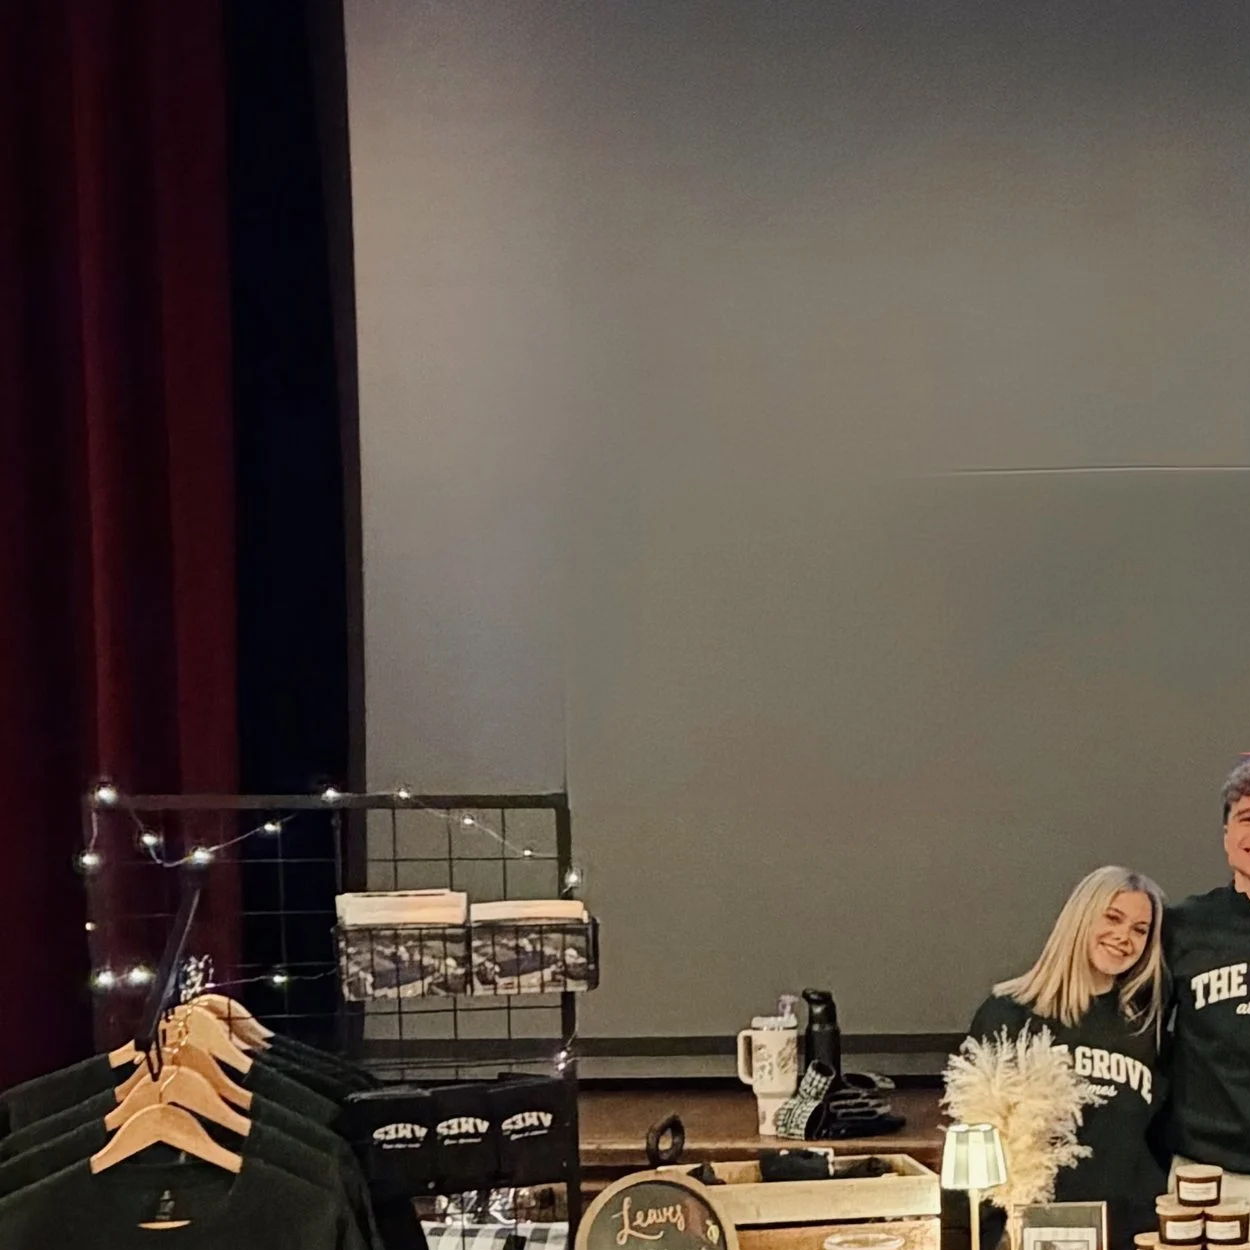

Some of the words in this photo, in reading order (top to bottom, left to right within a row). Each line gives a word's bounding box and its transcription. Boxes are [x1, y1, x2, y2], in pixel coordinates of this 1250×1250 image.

[1191, 963, 1248, 1010] THE
[1075, 1045, 1153, 1105] GROVE
[611, 1196, 685, 1245] Leaves
